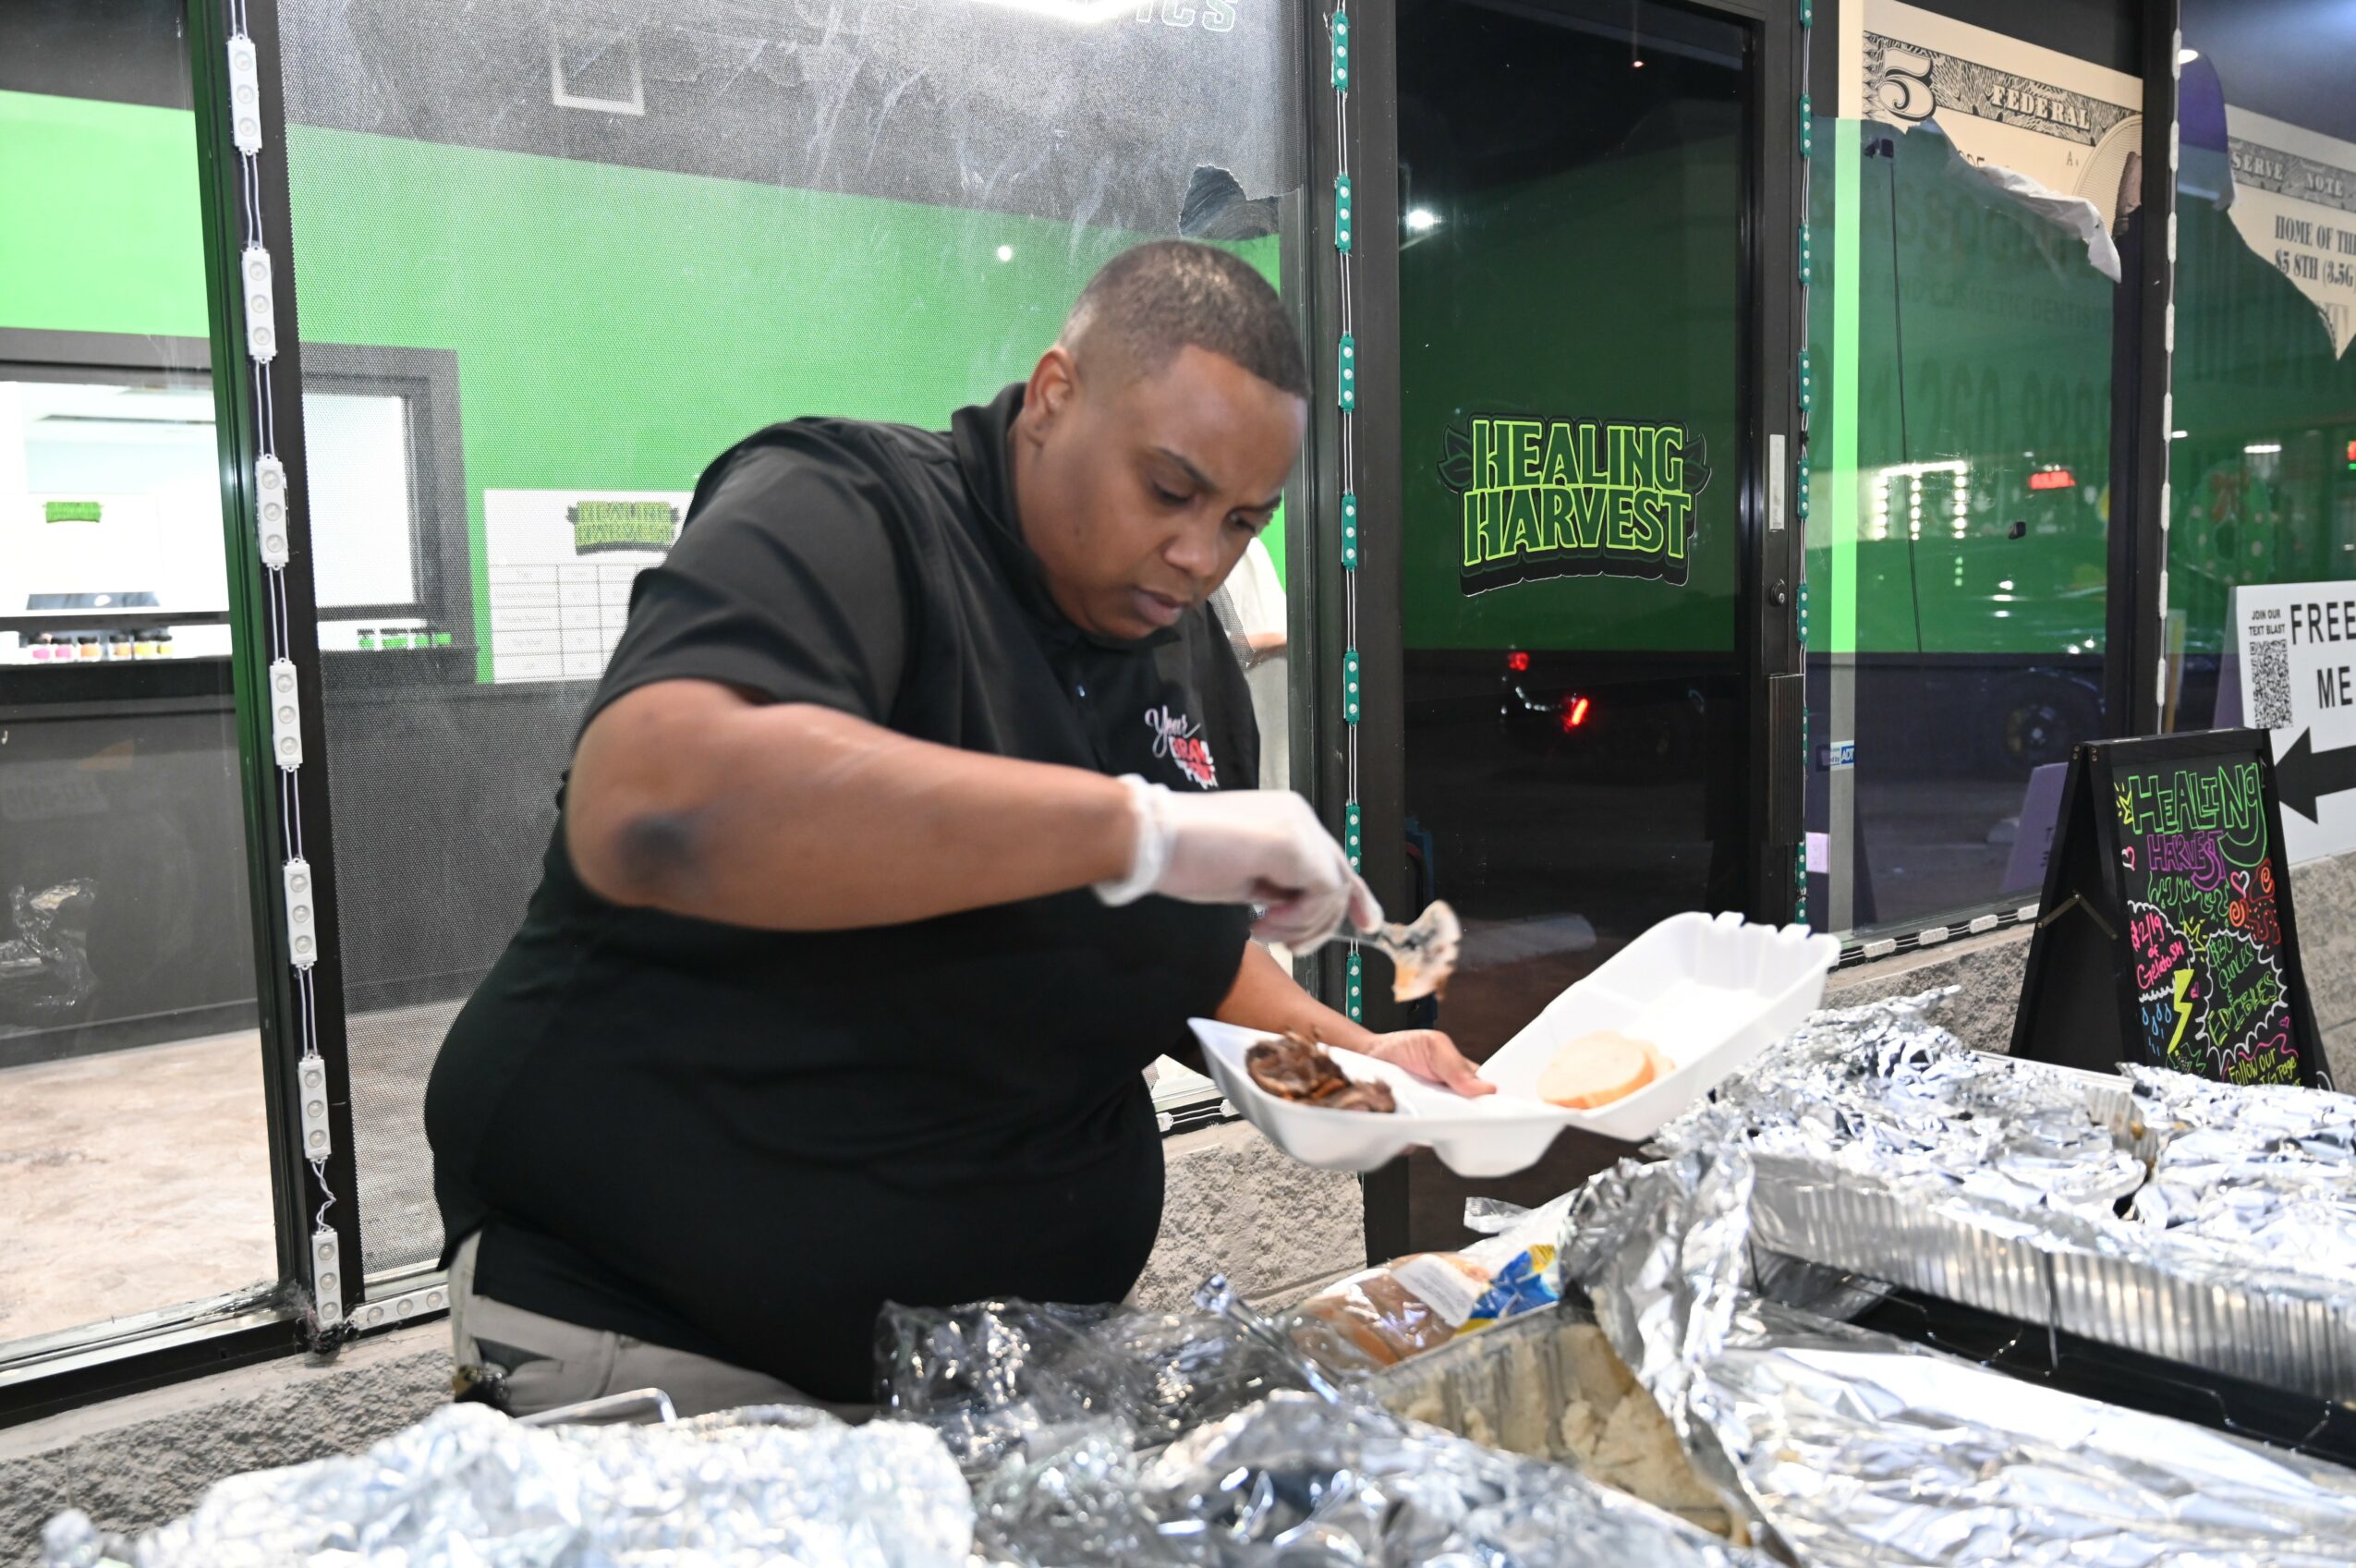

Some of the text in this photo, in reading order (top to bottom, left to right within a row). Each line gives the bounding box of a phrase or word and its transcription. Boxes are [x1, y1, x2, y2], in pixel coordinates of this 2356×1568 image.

[1877, 47, 1937, 122] 5
[1990, 84, 2092, 130] FEDERAL
[2306, 172, 2344, 197] NOTE
[2275, 214, 2313, 246] HOME
[2316, 225, 2334, 250] OF
[2275, 249, 2290, 275] $5
[2293, 253, 2318, 282] 8TH
[1473, 419, 1683, 492] HEALING
[1464, 484, 1692, 567] HARVEST
[2249, 624, 2286, 636] TEXT BLAST
[2252, 609, 2281, 621] JOIN OUR
[2290, 601, 2356, 645] FREE
[2146, 830, 2227, 892] HARVEST
[2207, 970, 2277, 1047] EDIBLES
